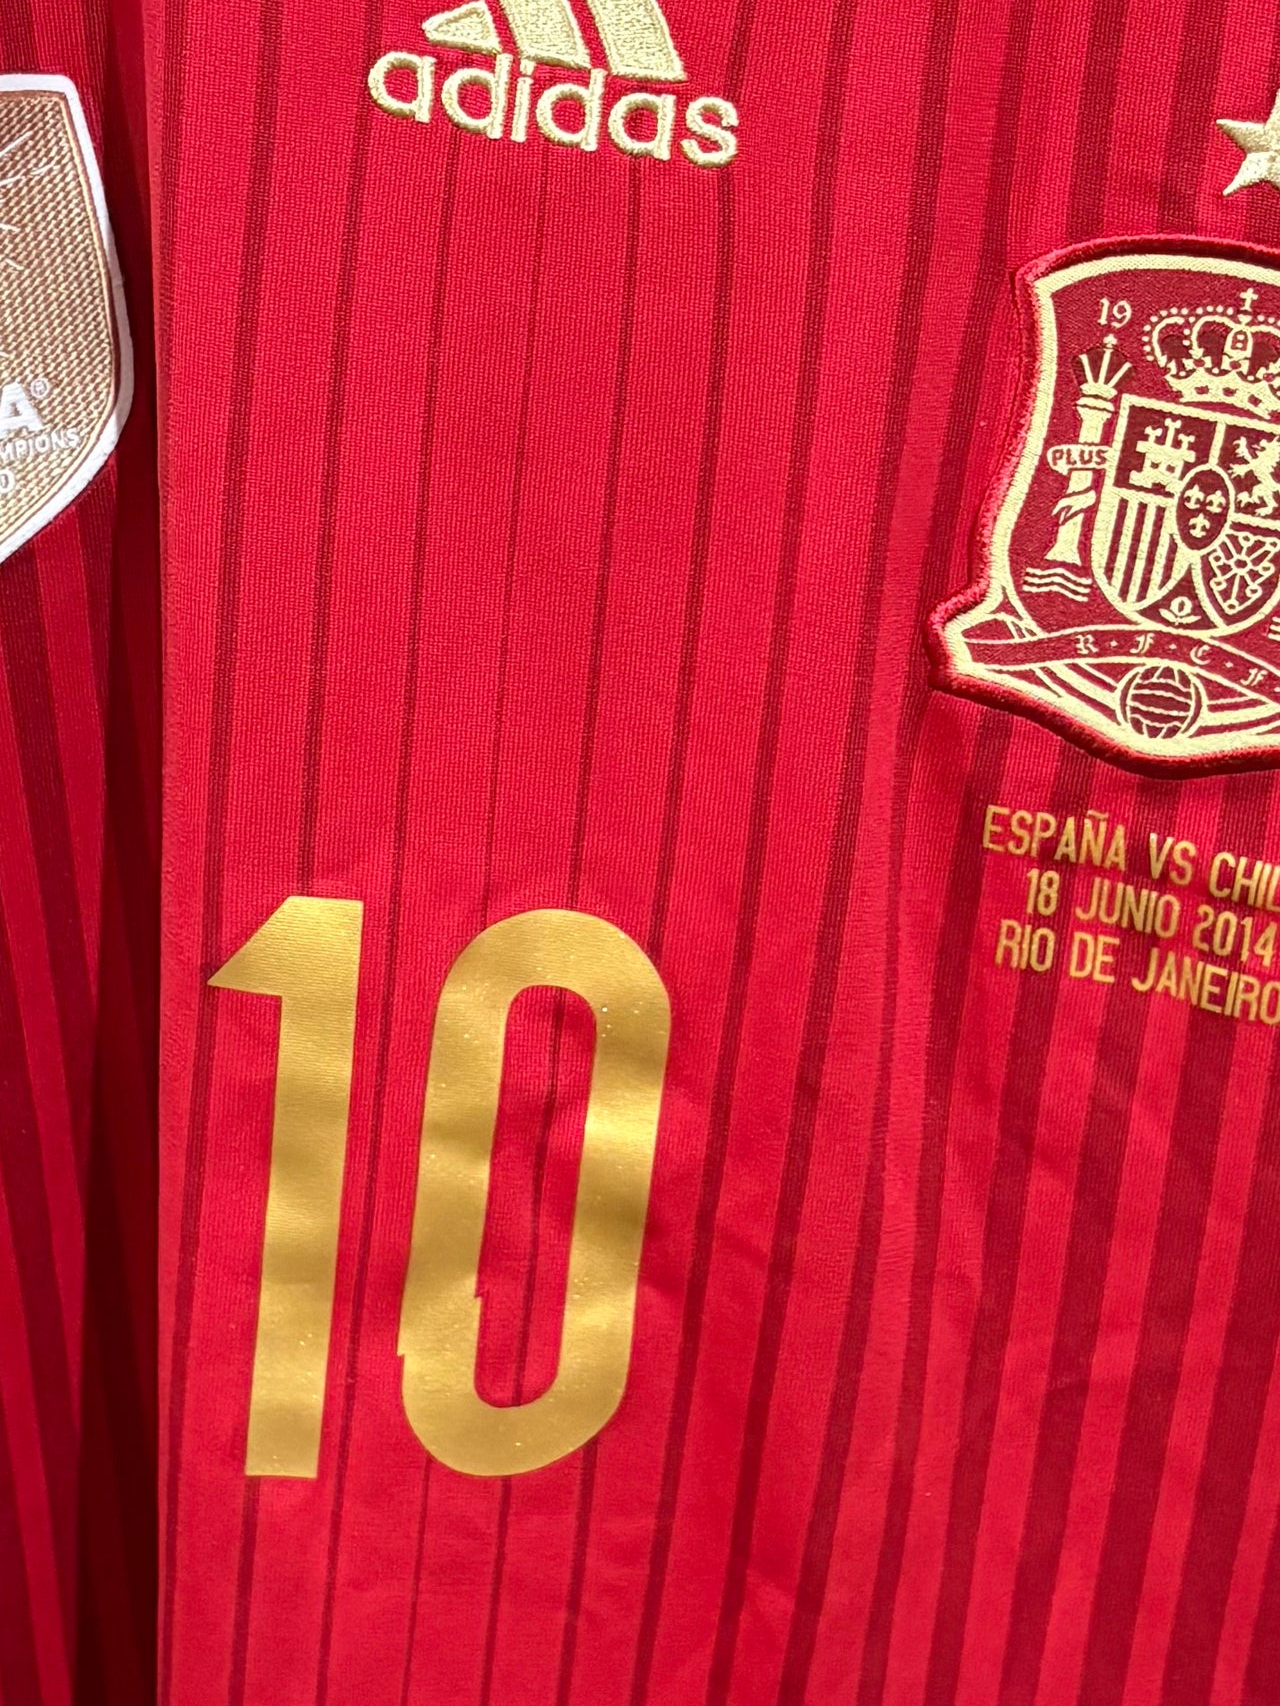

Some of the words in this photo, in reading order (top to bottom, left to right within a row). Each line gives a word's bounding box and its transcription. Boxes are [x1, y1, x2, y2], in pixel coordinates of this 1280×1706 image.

[367, 50, 740, 169] adidas
[1097, 297, 1133, 329] 19
[1051, 446, 1109, 467] PLUS
[981, 804, 1127, 872] ESPAÑA
[1148, 832, 1198, 887] VS
[994, 919, 1056, 974] RIO
[1068, 931, 1121, 985] DE
[1025, 867, 1061, 917] 18
[1074, 876, 1181, 940] JUNIO
[1191, 903, 1279, 969] 2014
[206, 894, 672, 1479] 10
